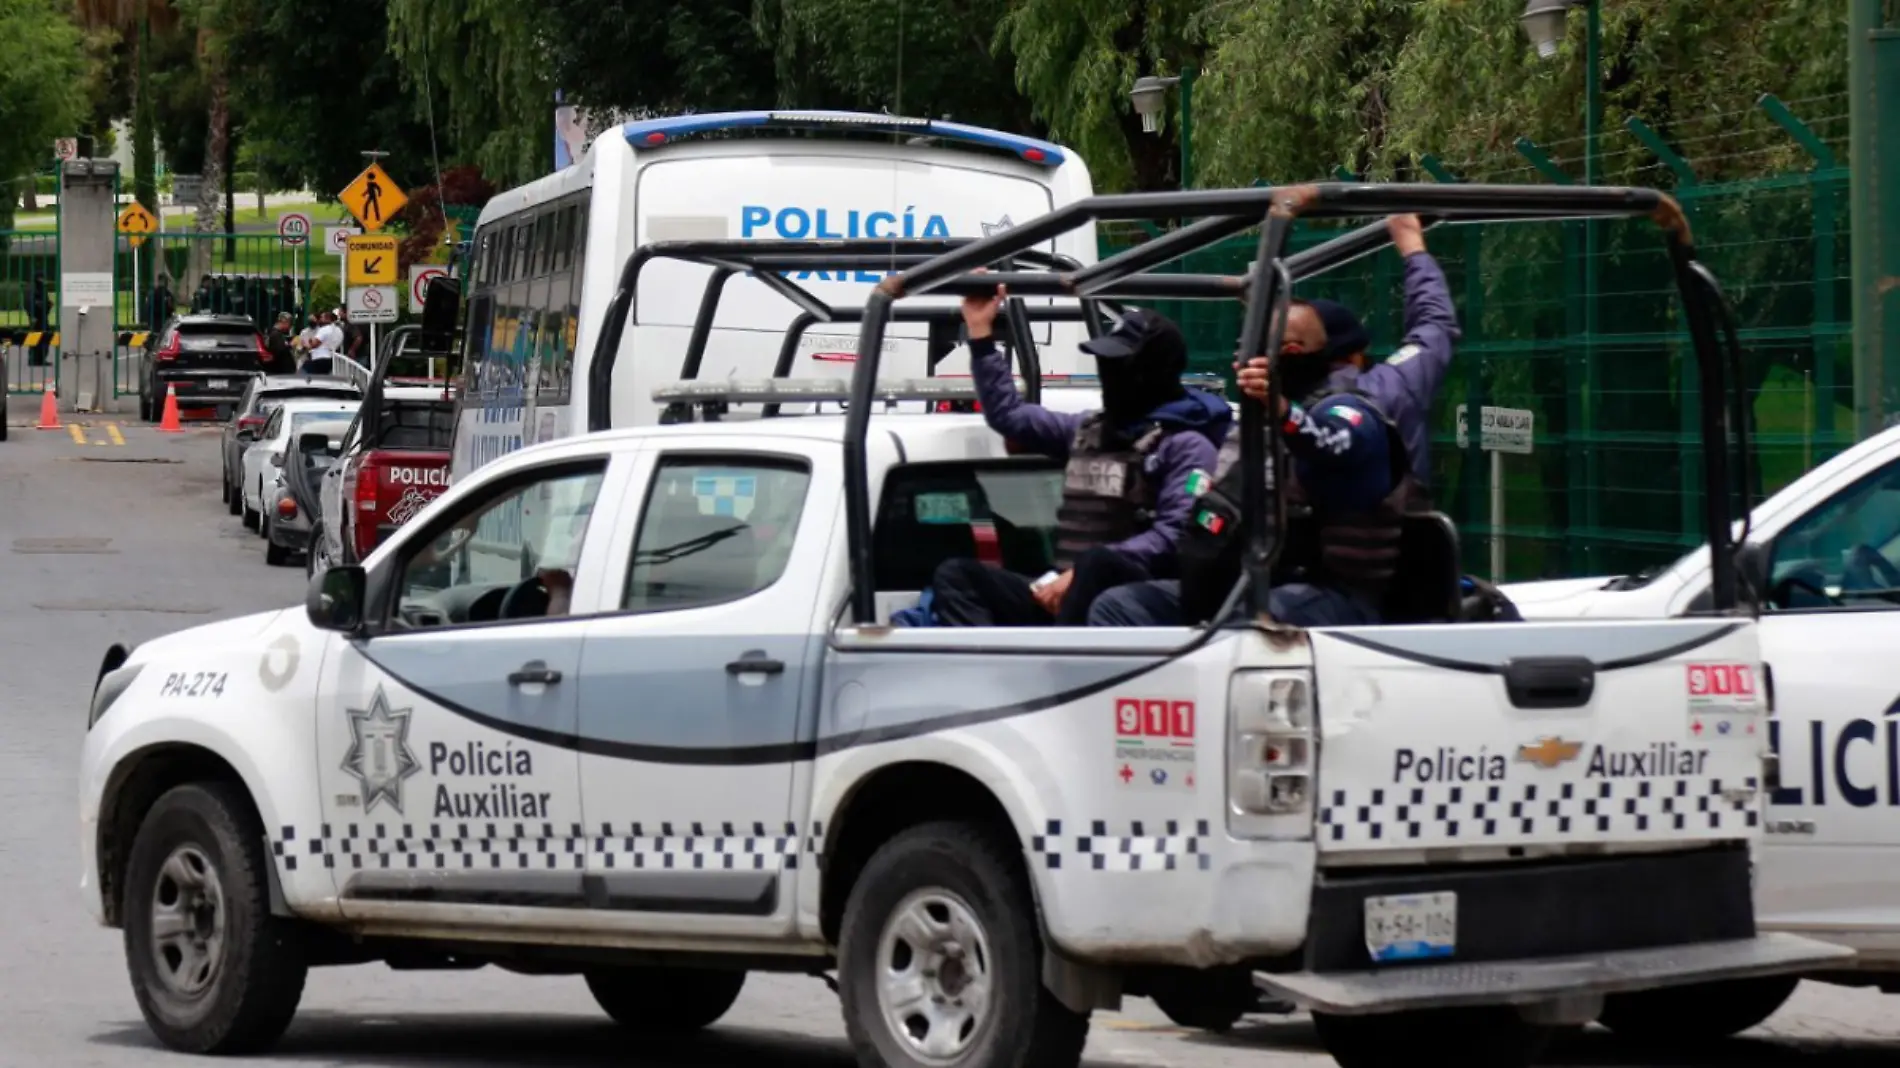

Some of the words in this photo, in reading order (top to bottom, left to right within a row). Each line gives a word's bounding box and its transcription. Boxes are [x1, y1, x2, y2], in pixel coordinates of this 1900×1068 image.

[286, 221, 303, 233] 40
[741, 205, 950, 239] POLICÍA
[349, 242, 394, 251] COMUNIDAD
[160, 672, 228, 699] PA-274
[1688, 667, 1752, 693] 911
[1119, 703, 1190, 732] 911
[430, 740, 532, 776] Policía
[1394, 745, 1505, 783] Policía
[1585, 741, 1708, 778] Auxiliar
[434, 783, 551, 818] Auxiliar
